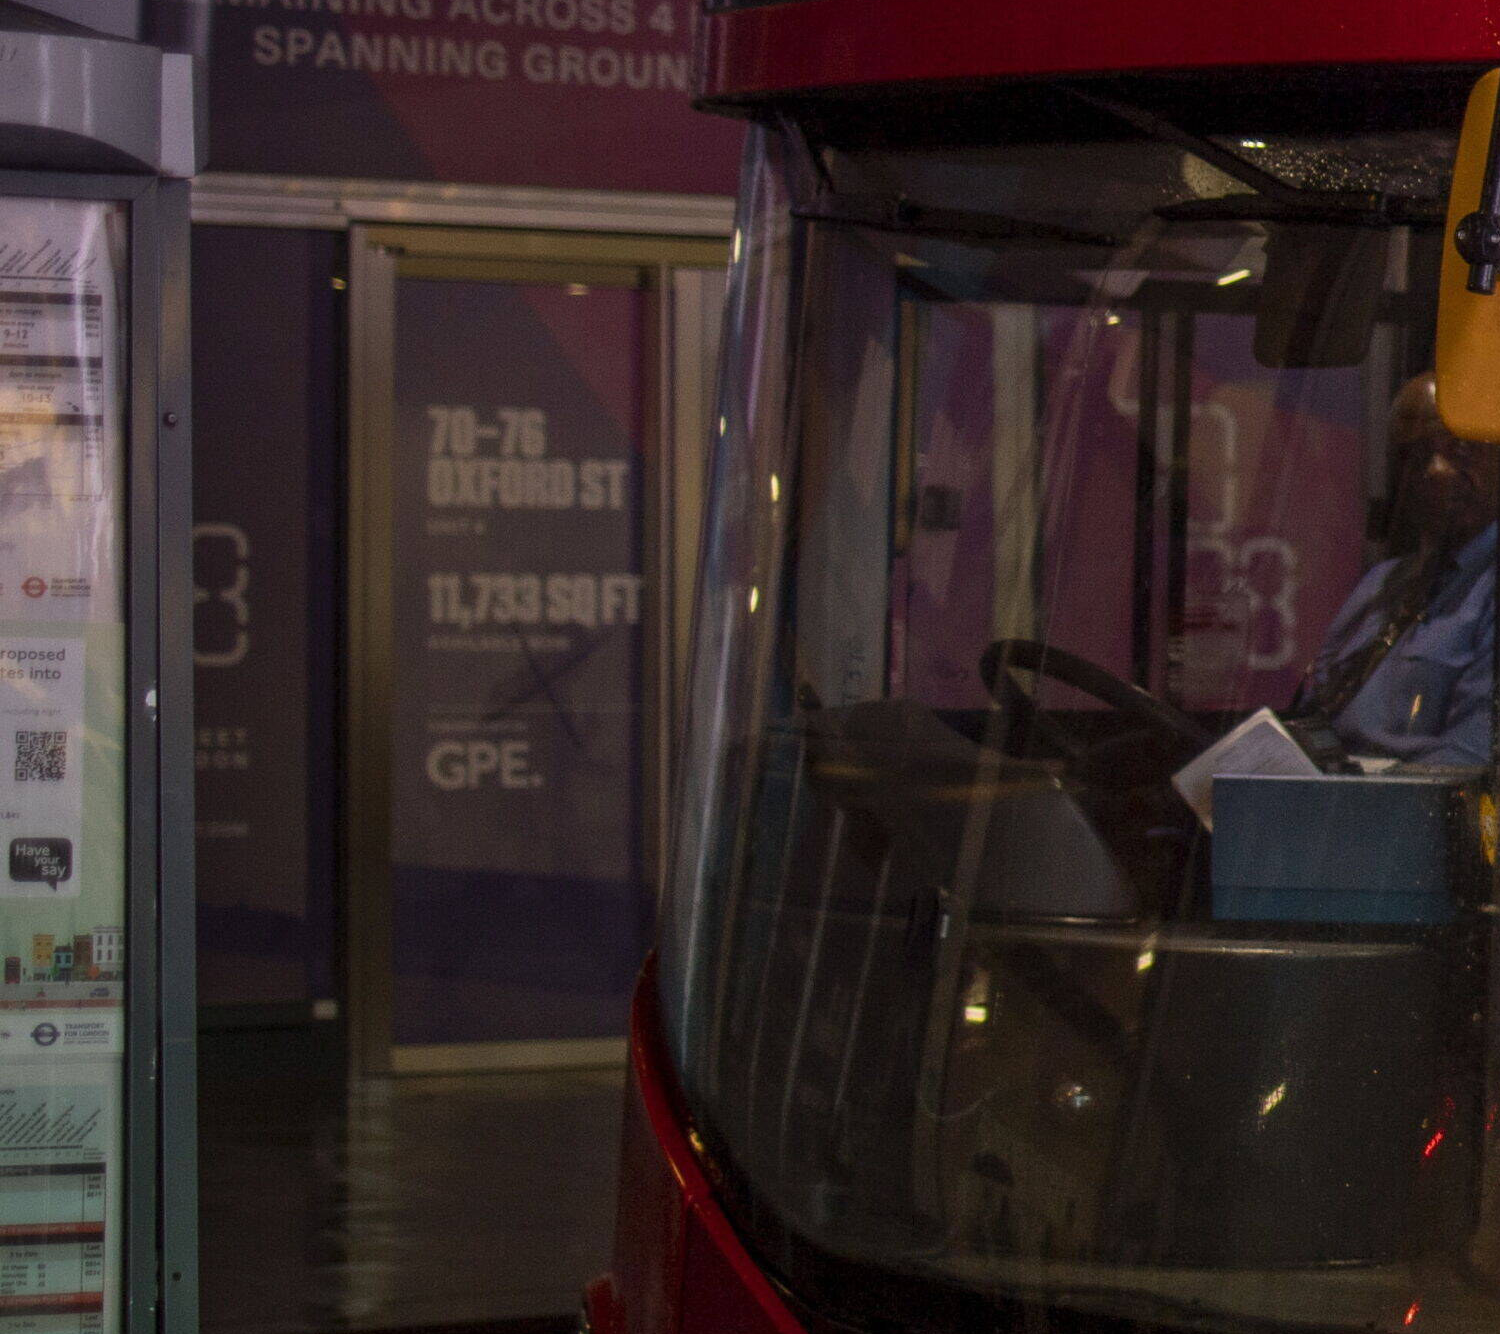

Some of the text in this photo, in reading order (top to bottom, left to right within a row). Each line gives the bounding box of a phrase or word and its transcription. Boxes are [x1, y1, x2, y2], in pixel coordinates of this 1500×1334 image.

[253, 24, 508, 81] SPANNING
[427, 458, 630, 510] OXFORD ST
[546, 572, 597, 630] SQ
[601, 573, 642, 625] FT
[29, 667, 62, 680] into
[15, 843, 50, 856] Have
[34, 856, 60, 867] your
[41, 865, 67, 878] say
